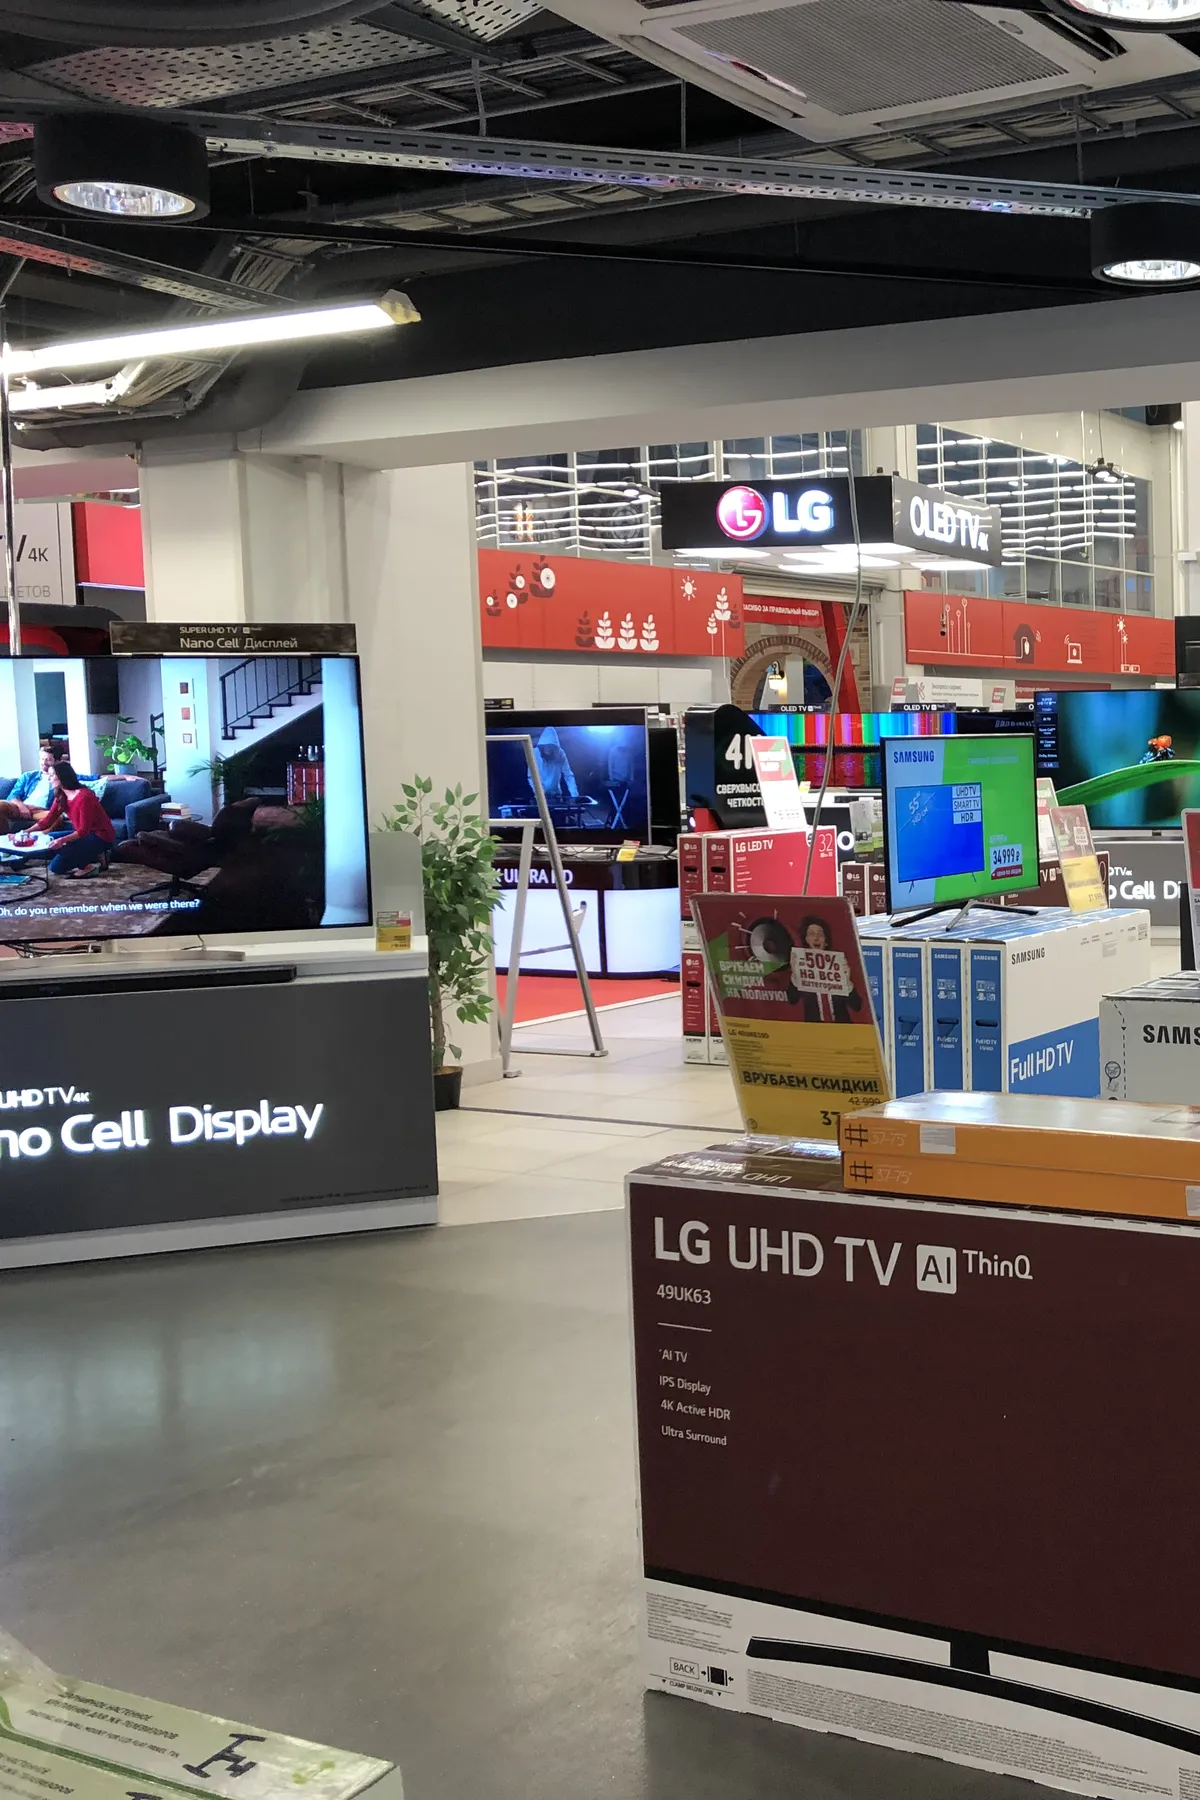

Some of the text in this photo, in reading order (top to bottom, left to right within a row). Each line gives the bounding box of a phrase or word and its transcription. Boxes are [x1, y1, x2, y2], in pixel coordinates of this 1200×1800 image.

[773, 489, 834, 532] LG
[226, 626, 238, 634] TV
[180, 637, 298, 651] Nano Cell Дисплей
[893, 750, 935, 763] SAMSUNG
[968, 786, 977, 796] TV
[954, 801, 971, 810] SMART
[960, 812, 974, 823] HDR
[735, 838, 774, 853] LG LED TV
[818, 833, 833, 852] 32
[1120, 880, 1156, 900] Cell
[15, 899, 200, 918] do you remember when we were there?
[1011, 947, 1045, 965] SAMSUNG
[719, 960, 765, 973] ВРУБАЕМ
[722, 975, 765, 987] СКИДКИ
[800, 969, 841, 982] на все
[802, 981, 843, 991] категории
[726, 988, 789, 1002] НА ПОЛНУЮ!
[1010, 1039, 1074, 1084] Full HD TV
[742, 1070, 879, 1094] ВРУБАЕМ СКИДКИ!
[61, 1099, 325, 1152] Cell Display
[654, 1216, 1034, 1288] LG UHD TV AI ThinQ
[656, 1283, 712, 1306] 49UK63
[674, 1350, 688, 1364] TV
[659, 1374, 712, 1397] IPS Display
[660, 1399, 731, 1421] 4K Active HDR
[661, 1424, 728, 1447] Ultra Surround
[673, 1662, 695, 1676] BACK
[669, 1680, 686, 1689] CLAMP
